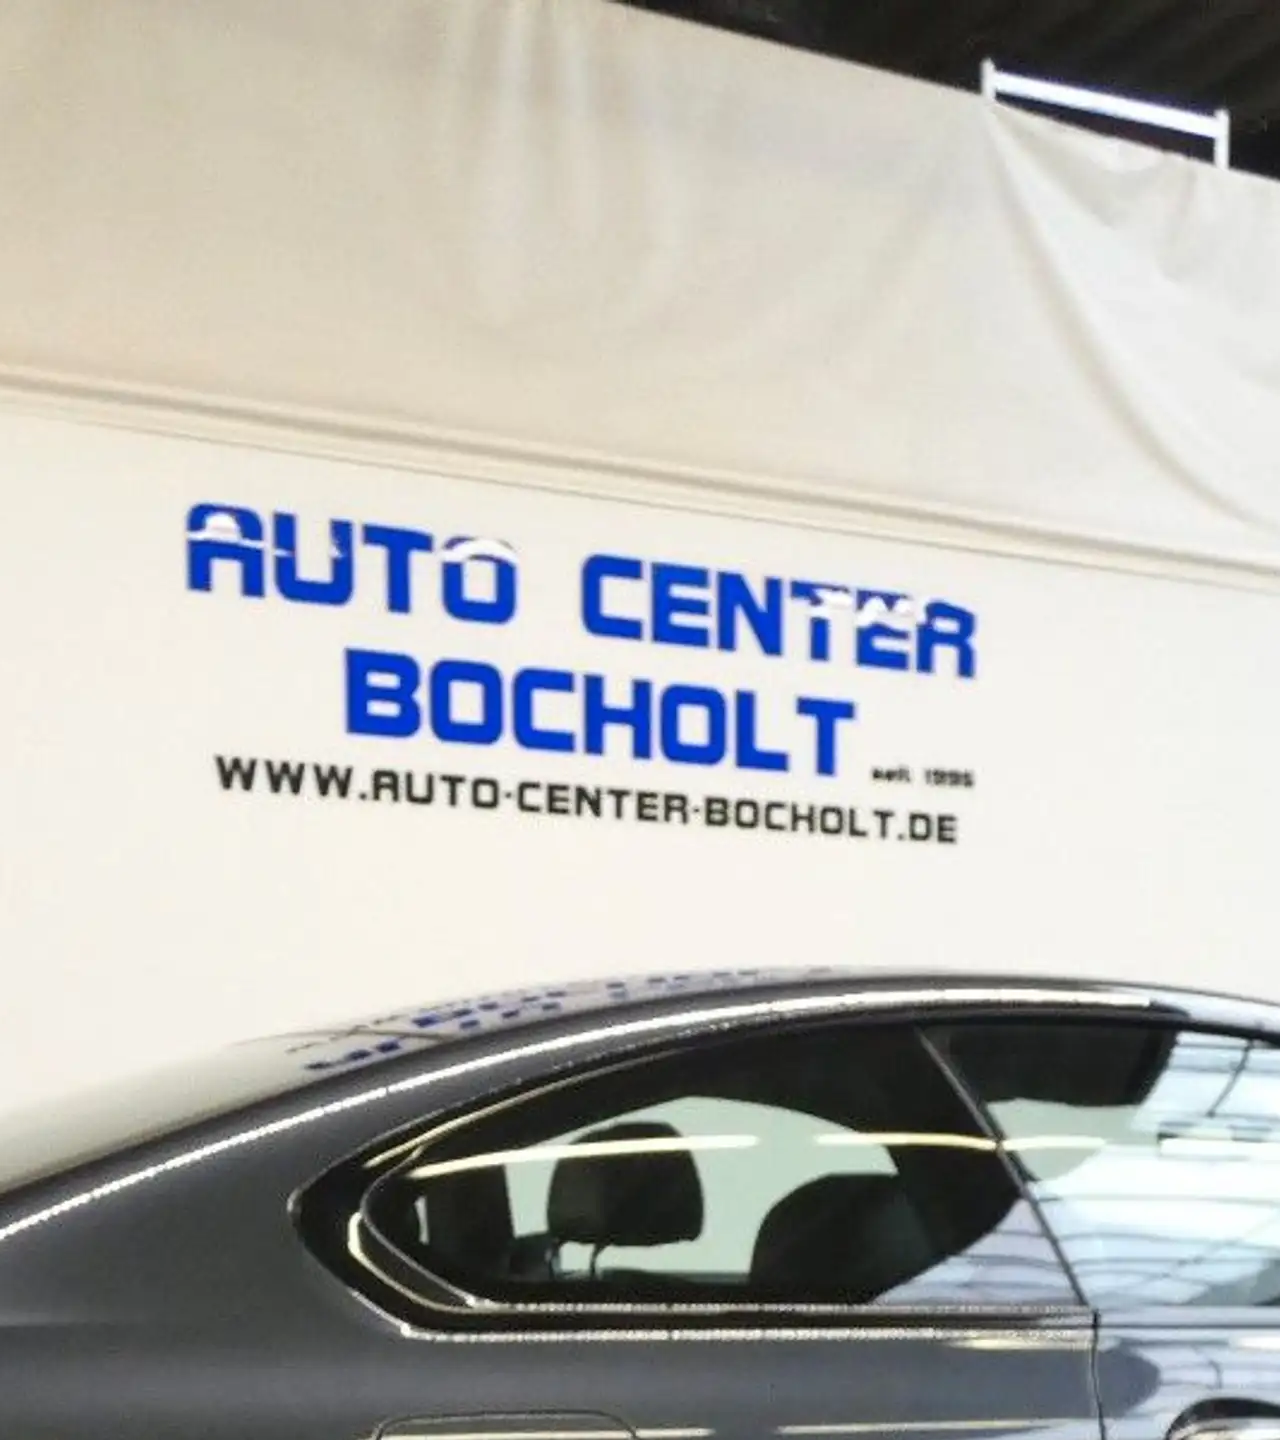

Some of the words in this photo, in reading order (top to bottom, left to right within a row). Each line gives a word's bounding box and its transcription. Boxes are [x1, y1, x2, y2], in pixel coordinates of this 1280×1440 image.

[187, 502, 518, 625] AUTO
[581, 554, 977, 679] CENTER
[344, 648, 856, 776] BOCHOLT
